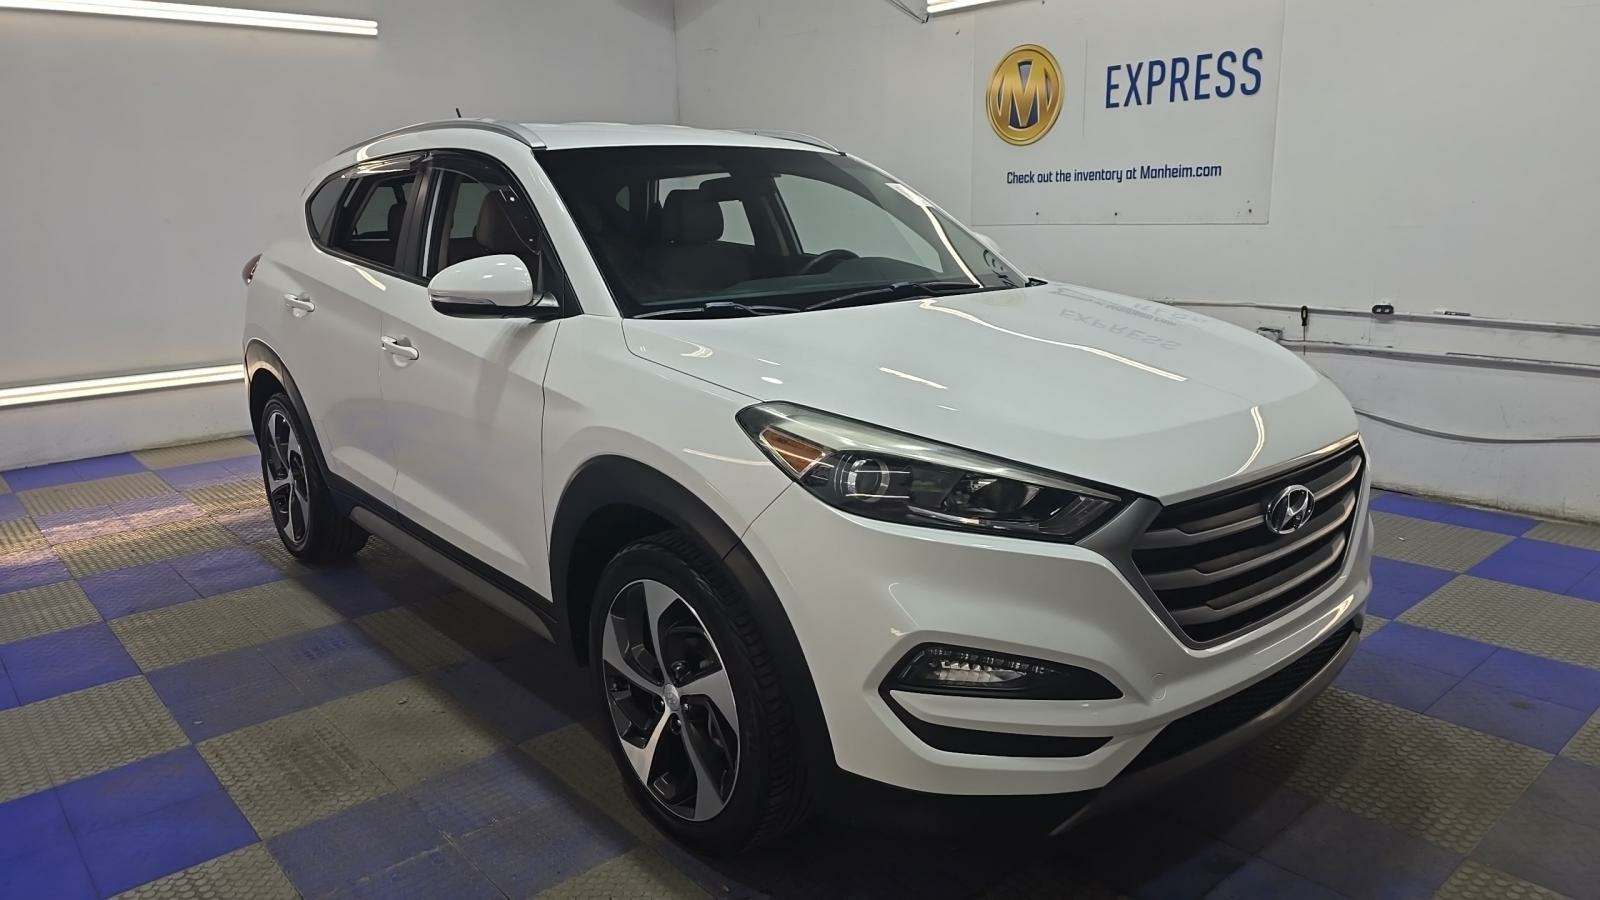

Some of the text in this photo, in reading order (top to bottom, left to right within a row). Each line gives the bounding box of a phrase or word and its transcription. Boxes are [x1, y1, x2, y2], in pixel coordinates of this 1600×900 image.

[1105, 47, 1263, 109] EXPRESS
[1006, 164, 1222, 184] Check out the inventory at Manheim.com
